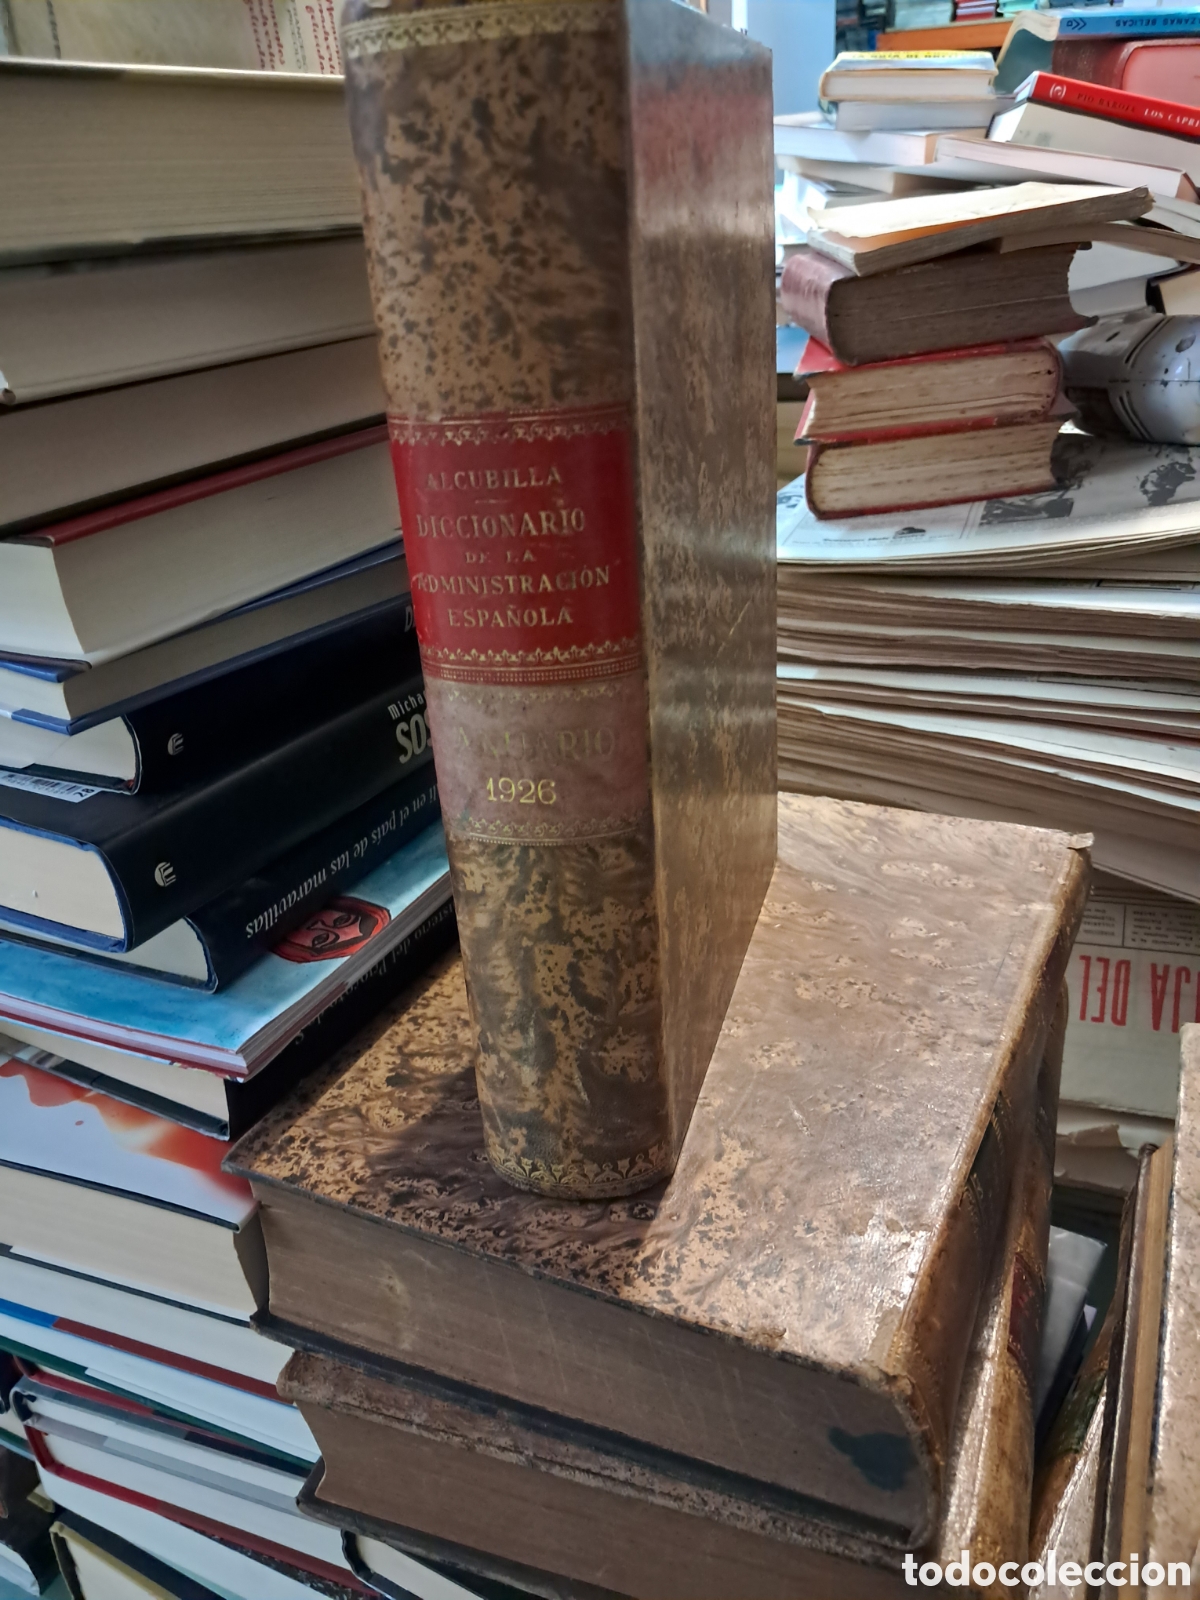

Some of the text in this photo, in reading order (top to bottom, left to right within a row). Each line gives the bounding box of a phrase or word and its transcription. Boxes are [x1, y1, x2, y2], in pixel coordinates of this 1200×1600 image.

[1143, 107, 1164, 120] LOS
[426, 467, 562, 491] ALCUBILLA
[416, 507, 585, 538] DICCIONARIO
[465, 549, 536, 564] DE LA
[448, 604, 574, 628] ESPAÑOLA
[412, 791, 427, 813] en
[486, 776, 557, 805] 1926
[371, 809, 396, 846] país
[399, 807, 410, 827] el
[353, 837, 369, 859] de
[330, 850, 350, 876] las
[244, 867, 328, 939] maravillas
[1079, 954, 1131, 1026] DEL
